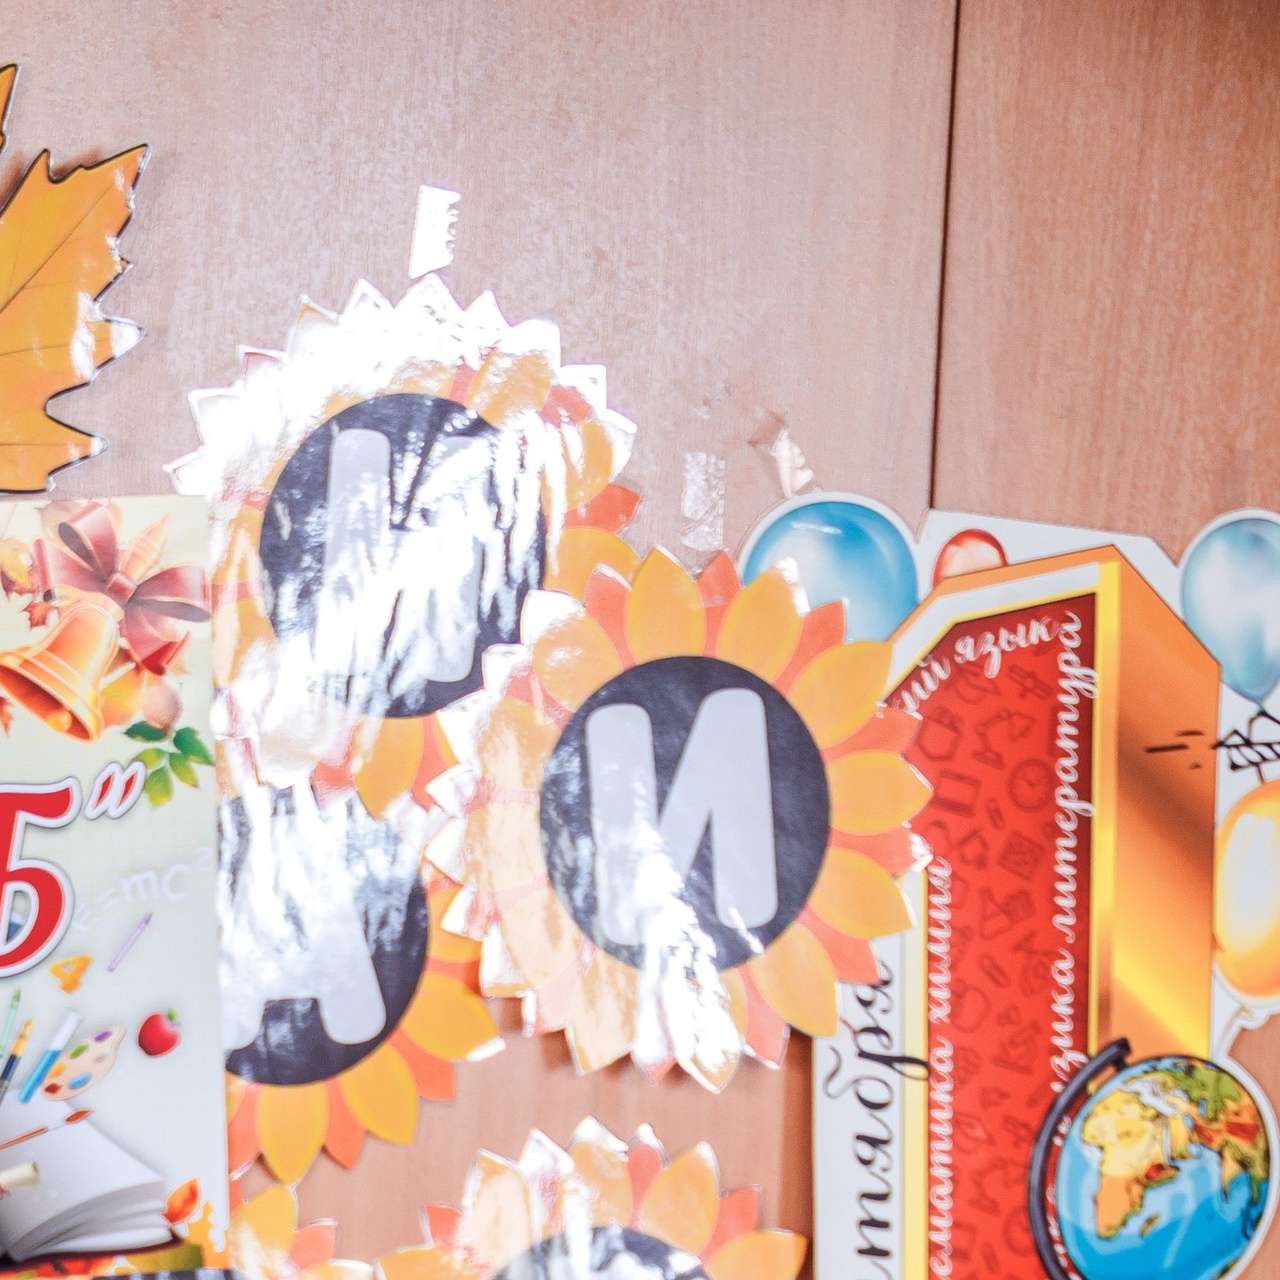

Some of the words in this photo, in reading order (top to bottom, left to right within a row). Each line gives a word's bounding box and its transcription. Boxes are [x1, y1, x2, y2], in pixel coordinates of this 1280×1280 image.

[954, 616, 1059, 678] язык
[1053, 610, 1099, 944] литература
[926, 856, 952, 1024] химия
